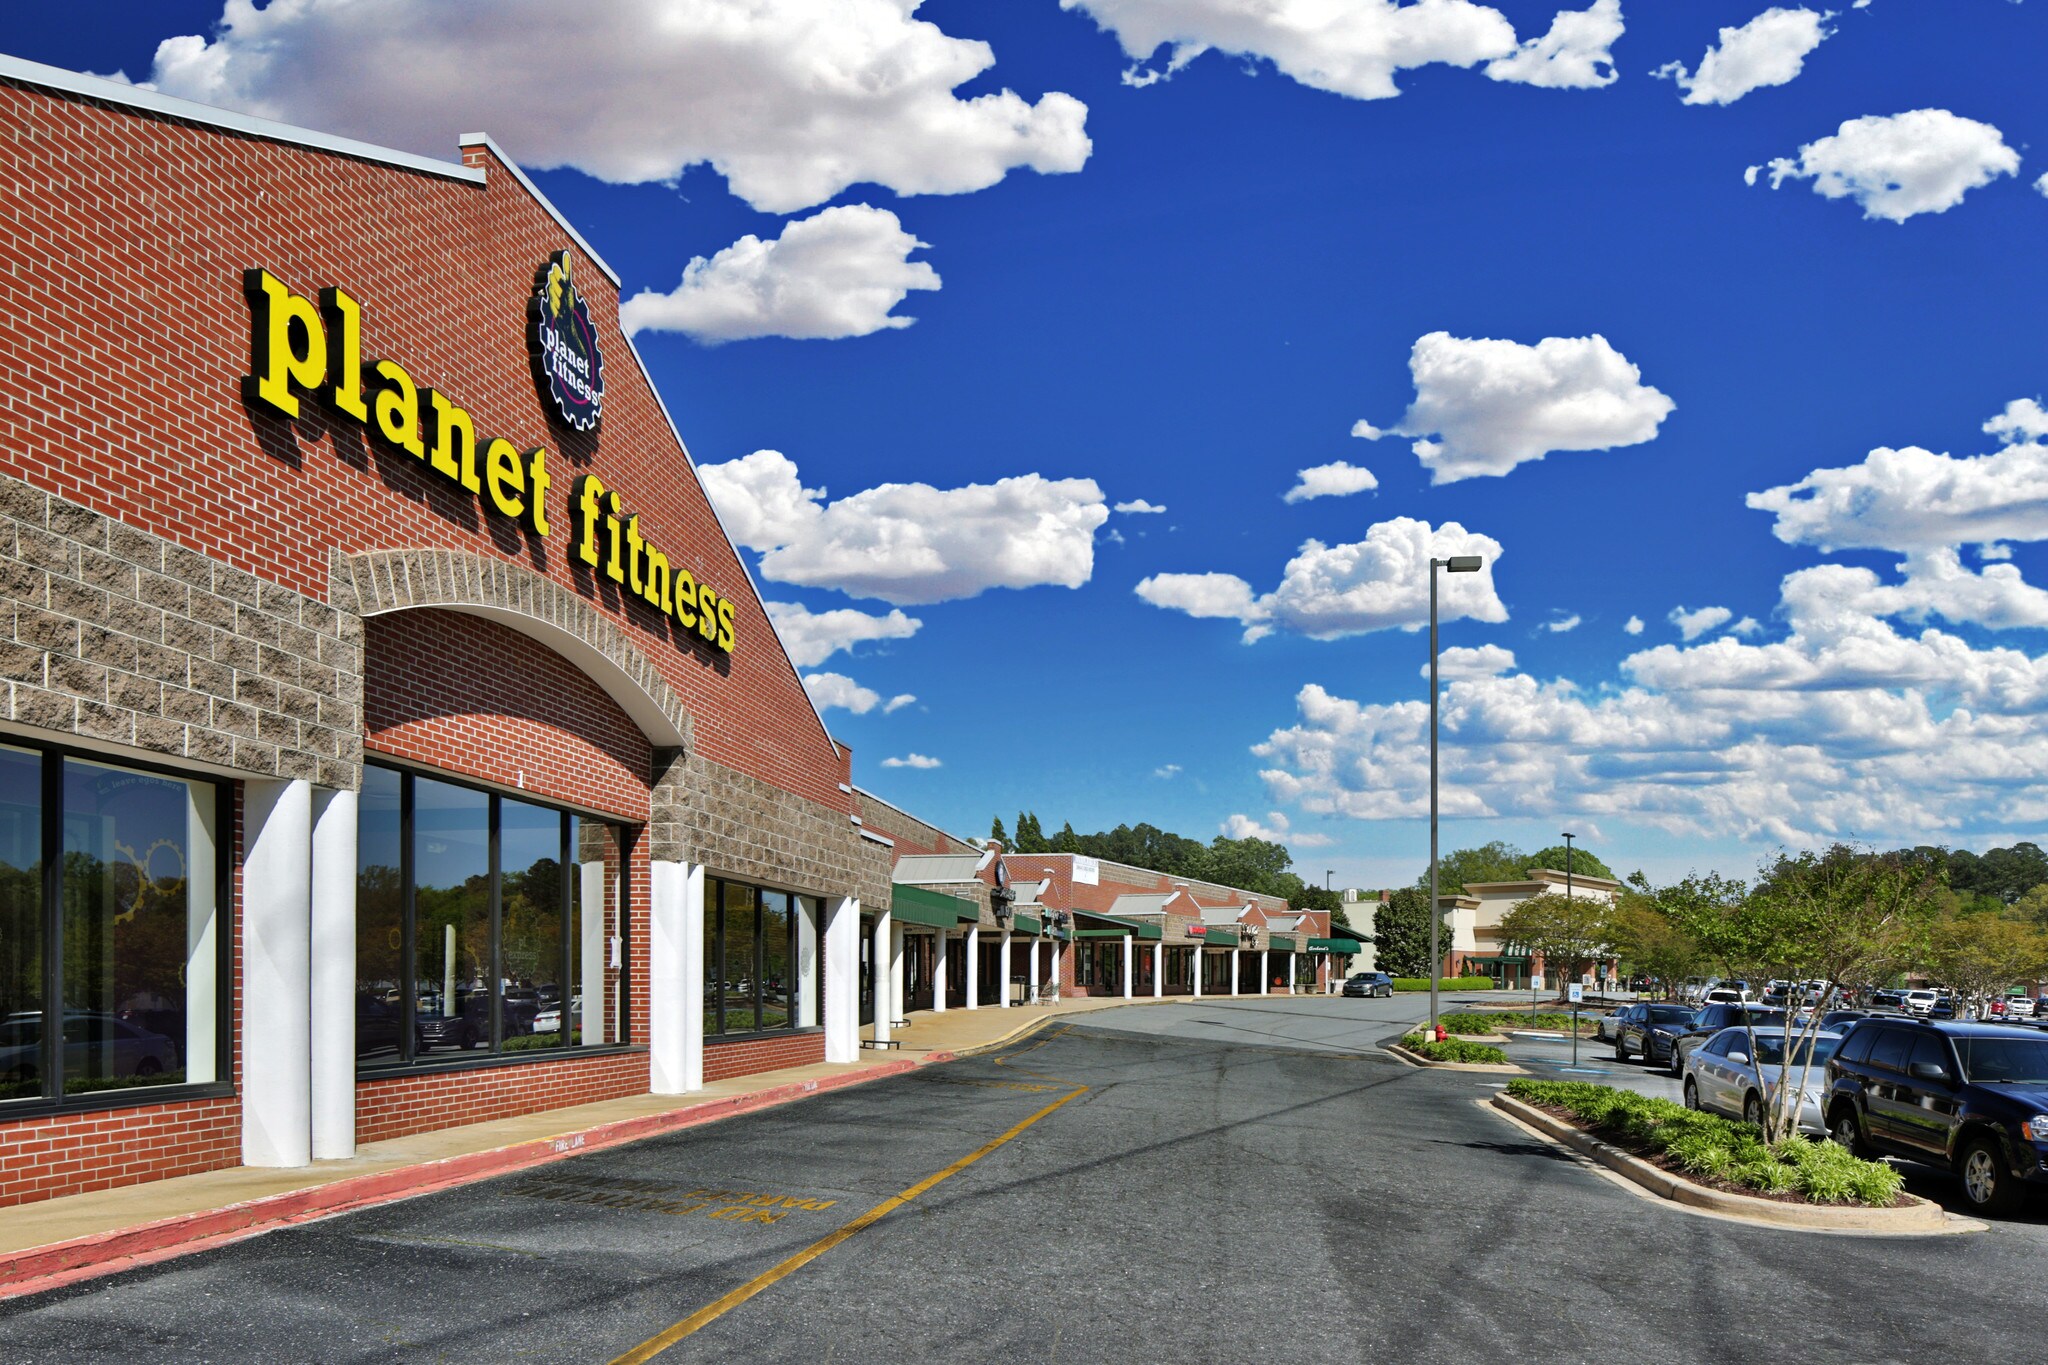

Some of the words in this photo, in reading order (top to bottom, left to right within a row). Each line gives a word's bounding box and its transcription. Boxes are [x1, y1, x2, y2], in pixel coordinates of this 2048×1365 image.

[546, 326, 590, 379] planet
[552, 353, 599, 407] fitness
[256, 268, 551, 537] planet
[577, 473, 735, 653] fitness
[111, 777, 136, 789] leave
[138, 776, 160, 786] egos
[161, 779, 183, 792] here
[707, 1205, 790, 1225] NO
